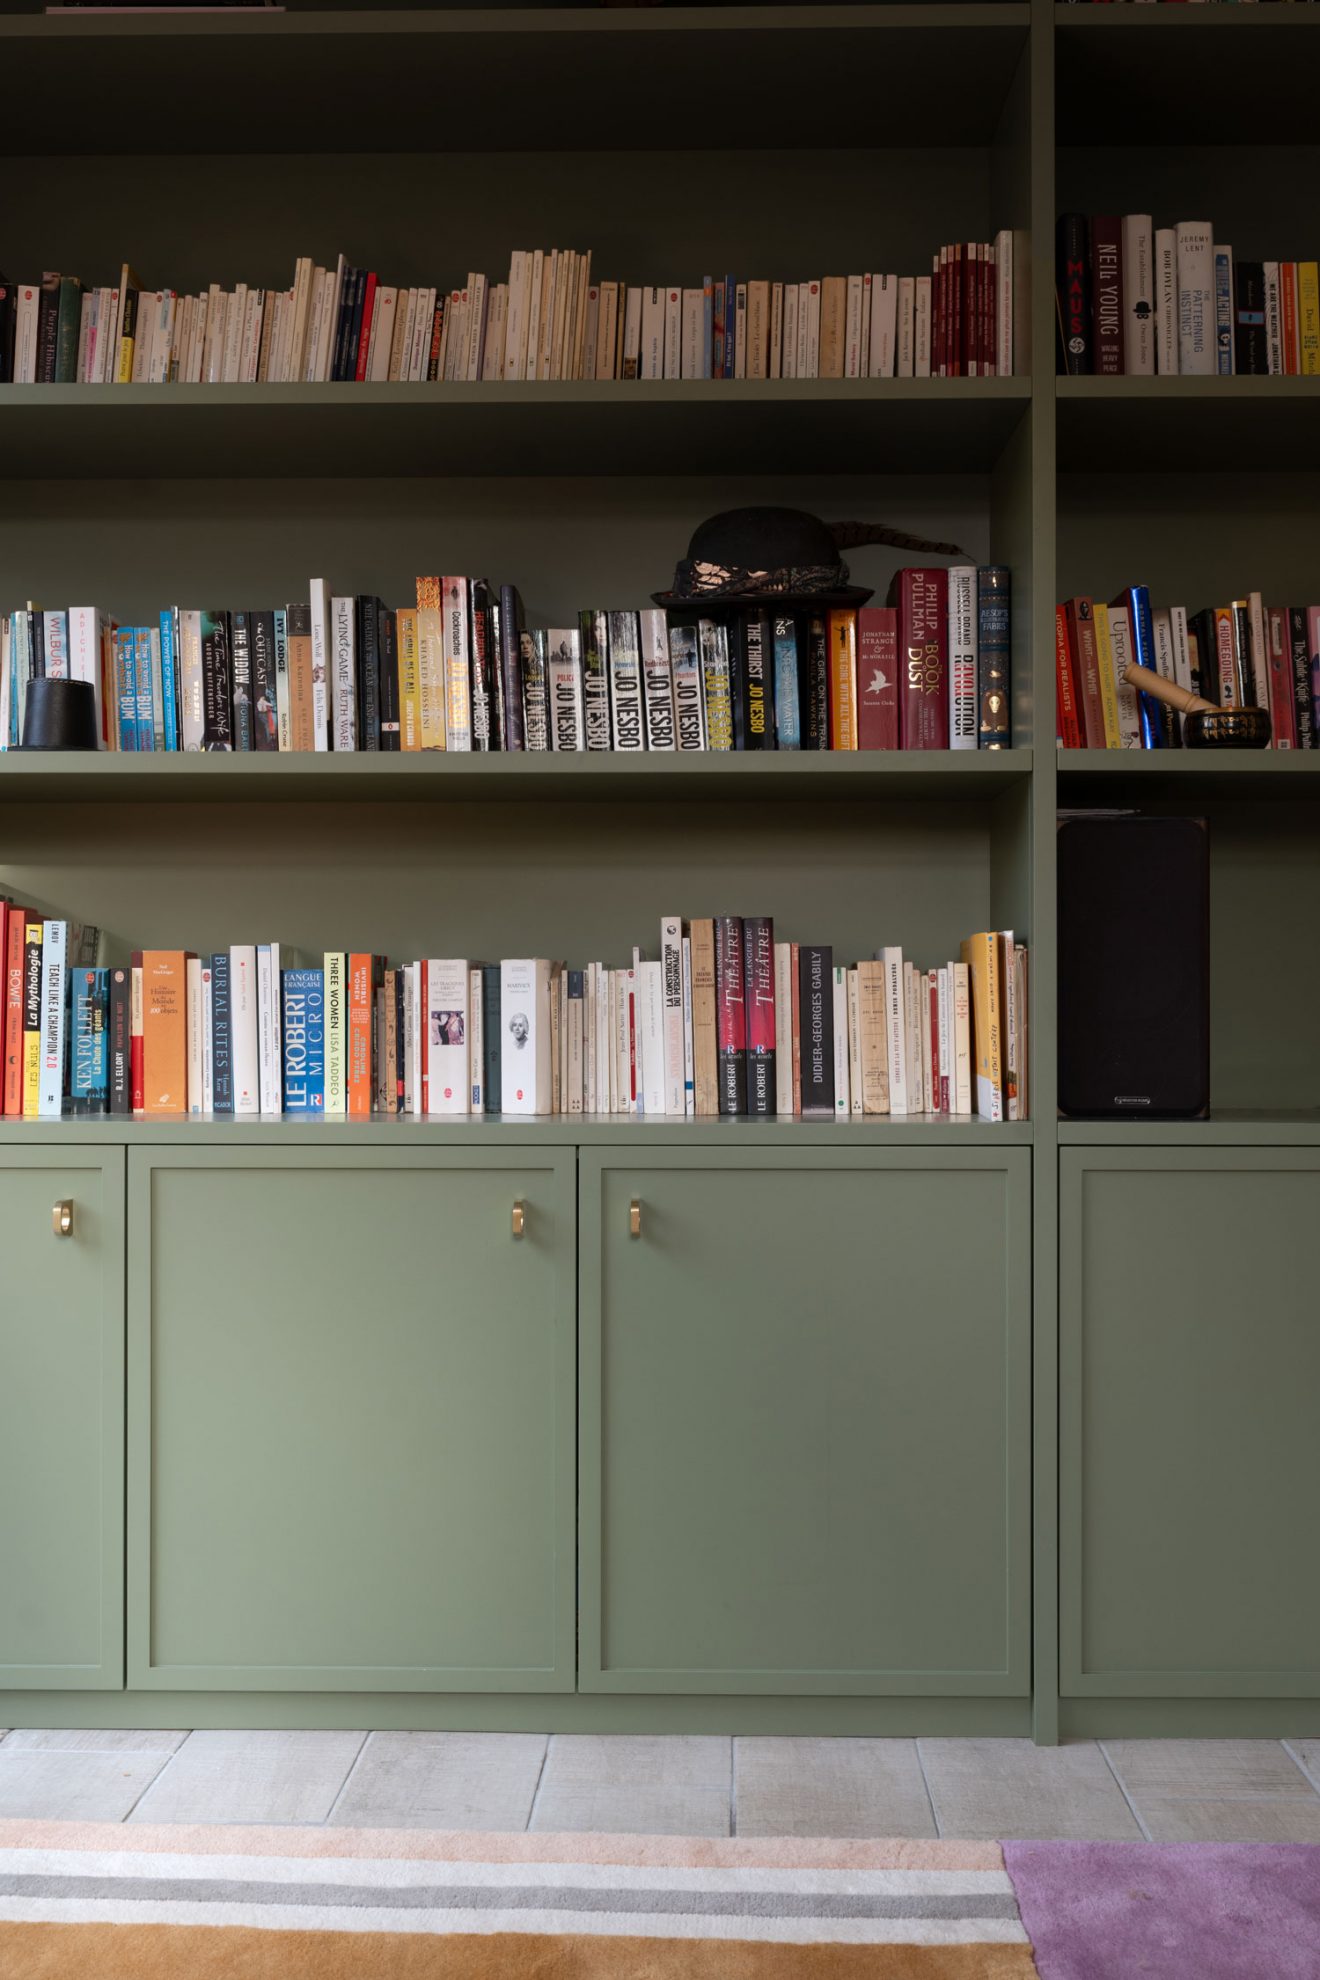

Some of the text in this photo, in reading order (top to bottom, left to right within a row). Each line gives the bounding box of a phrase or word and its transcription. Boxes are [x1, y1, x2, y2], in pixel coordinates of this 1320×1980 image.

[1068, 261, 1082, 334] MAUS
[1097, 244, 1118, 334] NEIL YOUNG
[46, 310, 56, 341] Purple
[1181, 290, 1191, 336] INSTINCT
[1193, 290, 1203, 352] PATTERNING
[338, 614, 348, 646] LYING
[912, 573, 924, 640] PULLMAN
[926, 584, 937, 629] PHILIP
[957, 577, 971, 645] RUSSELL BRAND
[50, 617, 62, 666] WILBUR
[234, 628, 249, 684] THE WIDOW
[452, 612, 460, 656] Cockroaches
[1110, 621, 1131, 685] Uprooted
[1220, 626, 1231, 683] HOMEGOING
[165, 666, 171, 676] OF
[338, 649, 348, 681] GAME
[585, 671, 608, 691] JO
[706, 672, 728, 690] JO
[747, 623, 764, 733] THE THIRST JO NESBO
[908, 648, 922, 692] DUST
[925, 645, 939, 695] BOOK
[1056, 615, 1071, 711] UTOPIA FOR REALISTS
[1083, 630, 1096, 695] WHAT WHAT
[1294, 640, 1308, 702] The Subtle Knife
[121, 697, 134, 719] BUM
[137, 696, 151, 720] BUM
[526, 683, 544, 700] JO
[615, 671, 640, 747] JO NESBO
[647, 670, 673, 747] JO NESBO
[678, 681, 701, 749] JO NESBO
[818, 685, 825, 698] ON
[955, 655, 974, 736] REVOLUTION
[340, 690, 348, 748] RUTH WARE
[474, 692, 489, 739] JO NESBO
[527, 705, 546, 750] NESBO
[556, 683, 577, 751] JO NESBO
[586, 697, 610, 748] NESBO
[708, 696, 732, 747] NESBO
[51, 924, 59, 944] LEMOV
[746, 928, 753, 939] DU
[9, 970, 21, 1008] BOWIE
[25, 949, 40, 1026] La Mythologie
[48, 964, 60, 987] TEACH
[285, 973, 321, 982] LANGUE
[665, 944, 673, 1007] LA CONSTRUCTION
[724, 927, 743, 1006] THÉÂTRE
[748, 977, 753, 987] LA
[754, 927, 774, 1006] THÉÂTRE
[48, 989, 59, 1006] LIKE
[215, 957, 228, 1067] BURIAL RITES
[331, 989, 339, 1029] WOMEN
[674, 997, 680, 1006] DU
[812, 952, 823, 1082] DIDIER-GEORGES GABILY
[47, 1015, 58, 1054] CHAMPION
[77, 994, 91, 1089] KEN FOLLETT
[93, 1009, 102, 1074] La Chute des géants
[285, 993, 306, 1106] LE ROBERT
[308, 993, 322, 1074] MICRO
[331, 1033, 339, 1053] LISA
[30, 1045, 38, 1087] LES NULS
[47, 1056, 57, 1069] 2.0
[331, 1057, 339, 1095] TADDEO
[727, 1064, 736, 1098] ROBERT
[728, 1102, 736, 1111] LE
[757, 1064, 766, 1111] LE ROBERT
